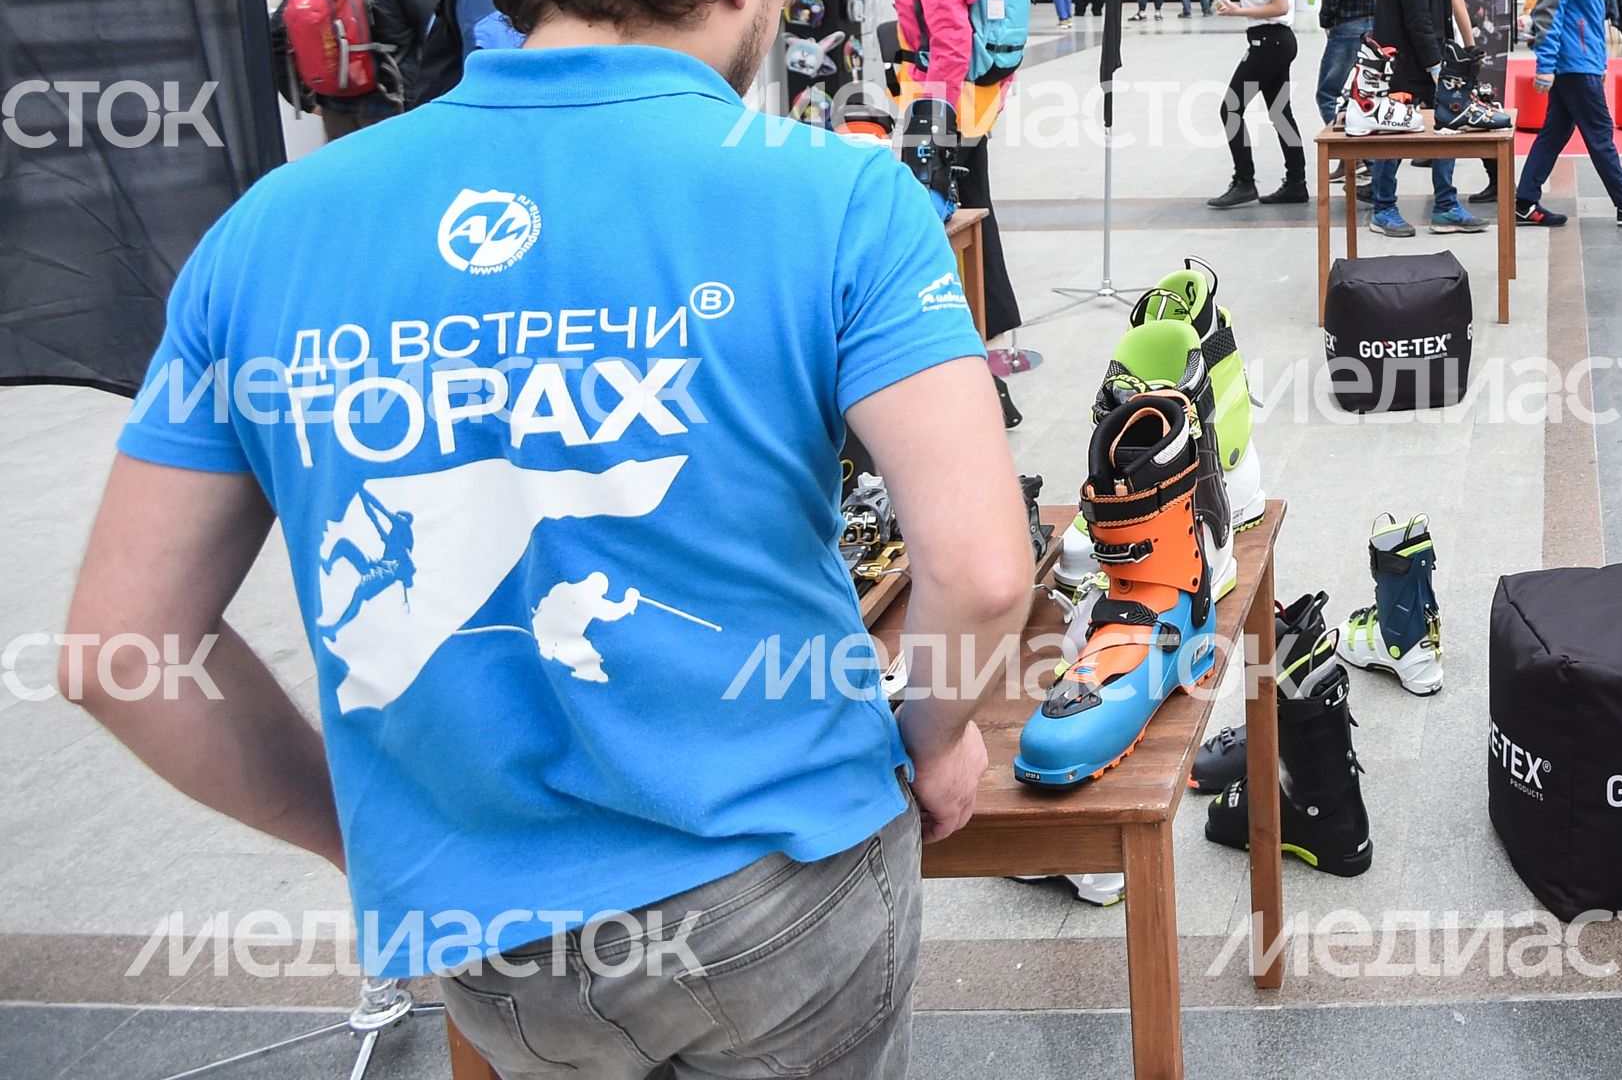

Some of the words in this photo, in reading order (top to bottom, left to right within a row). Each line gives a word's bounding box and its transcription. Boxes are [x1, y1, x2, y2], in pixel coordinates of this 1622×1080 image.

[1381, 119, 1411, 128] ATOMIC
[285, 323, 371, 384] ДО
[391, 306, 688, 365] ВСТРЕЧИ
[287, 358, 689, 469] ГОРАХ
[1510, 777, 1545, 802] PRODUCTS
